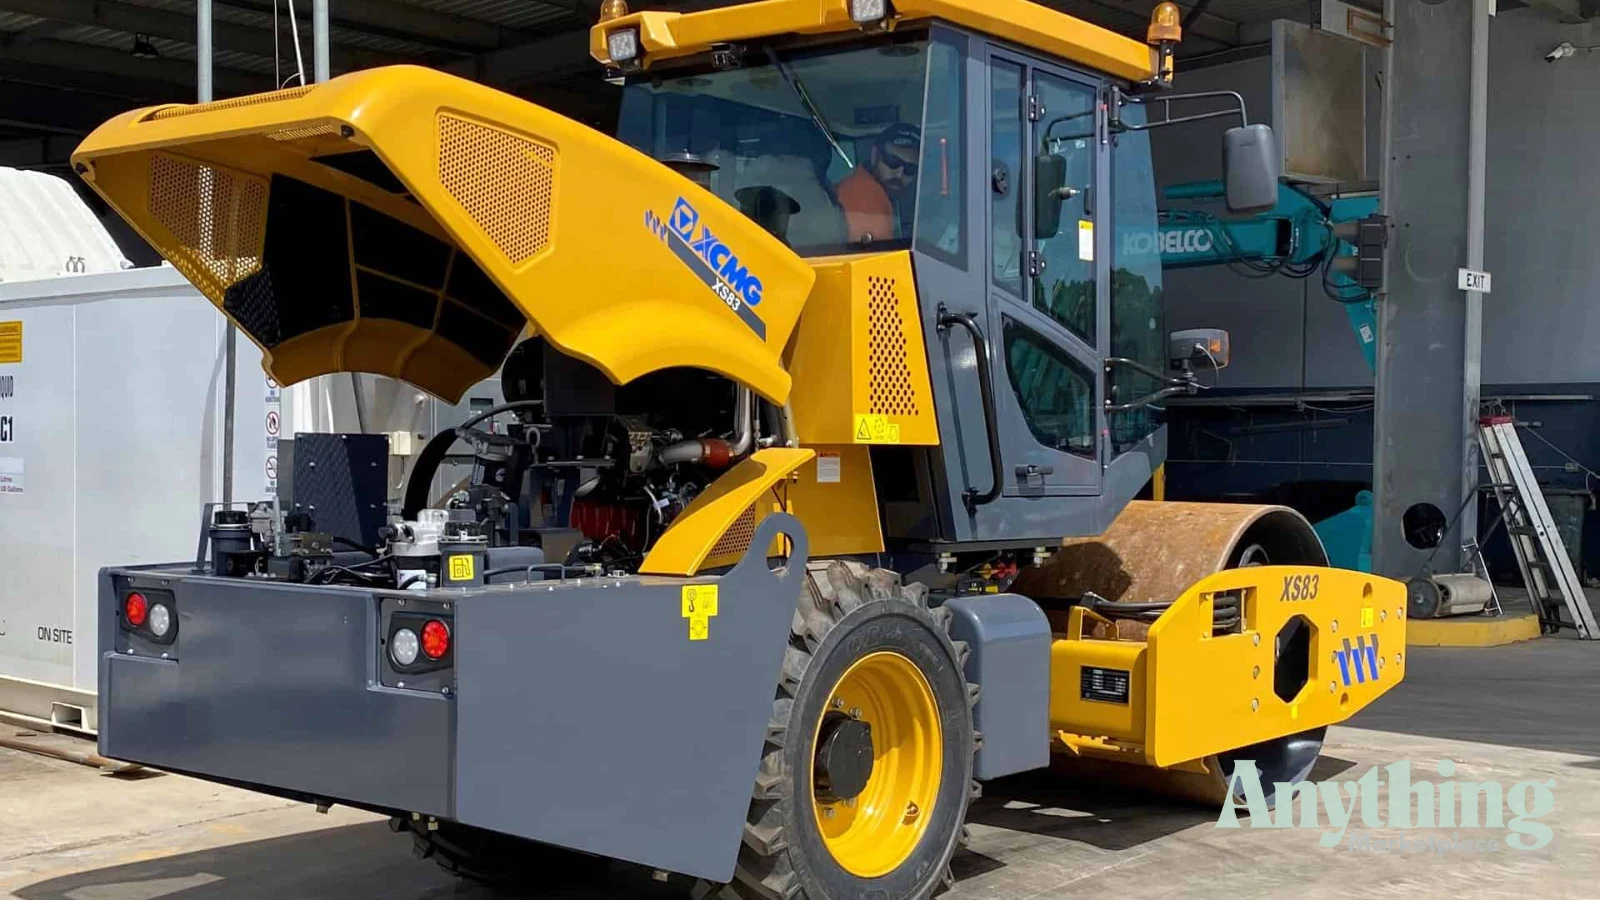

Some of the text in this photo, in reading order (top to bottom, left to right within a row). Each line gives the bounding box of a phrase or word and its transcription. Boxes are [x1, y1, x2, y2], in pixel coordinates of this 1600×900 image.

[1122, 229, 1214, 256] KOBELCO
[690, 223, 763, 307] XCMG
[711, 277, 741, 311] XS83
[1467, 272, 1485, 290] EXIT
[1279, 574, 1320, 602] XS83
[37, 626, 73, 644] ON SITE
